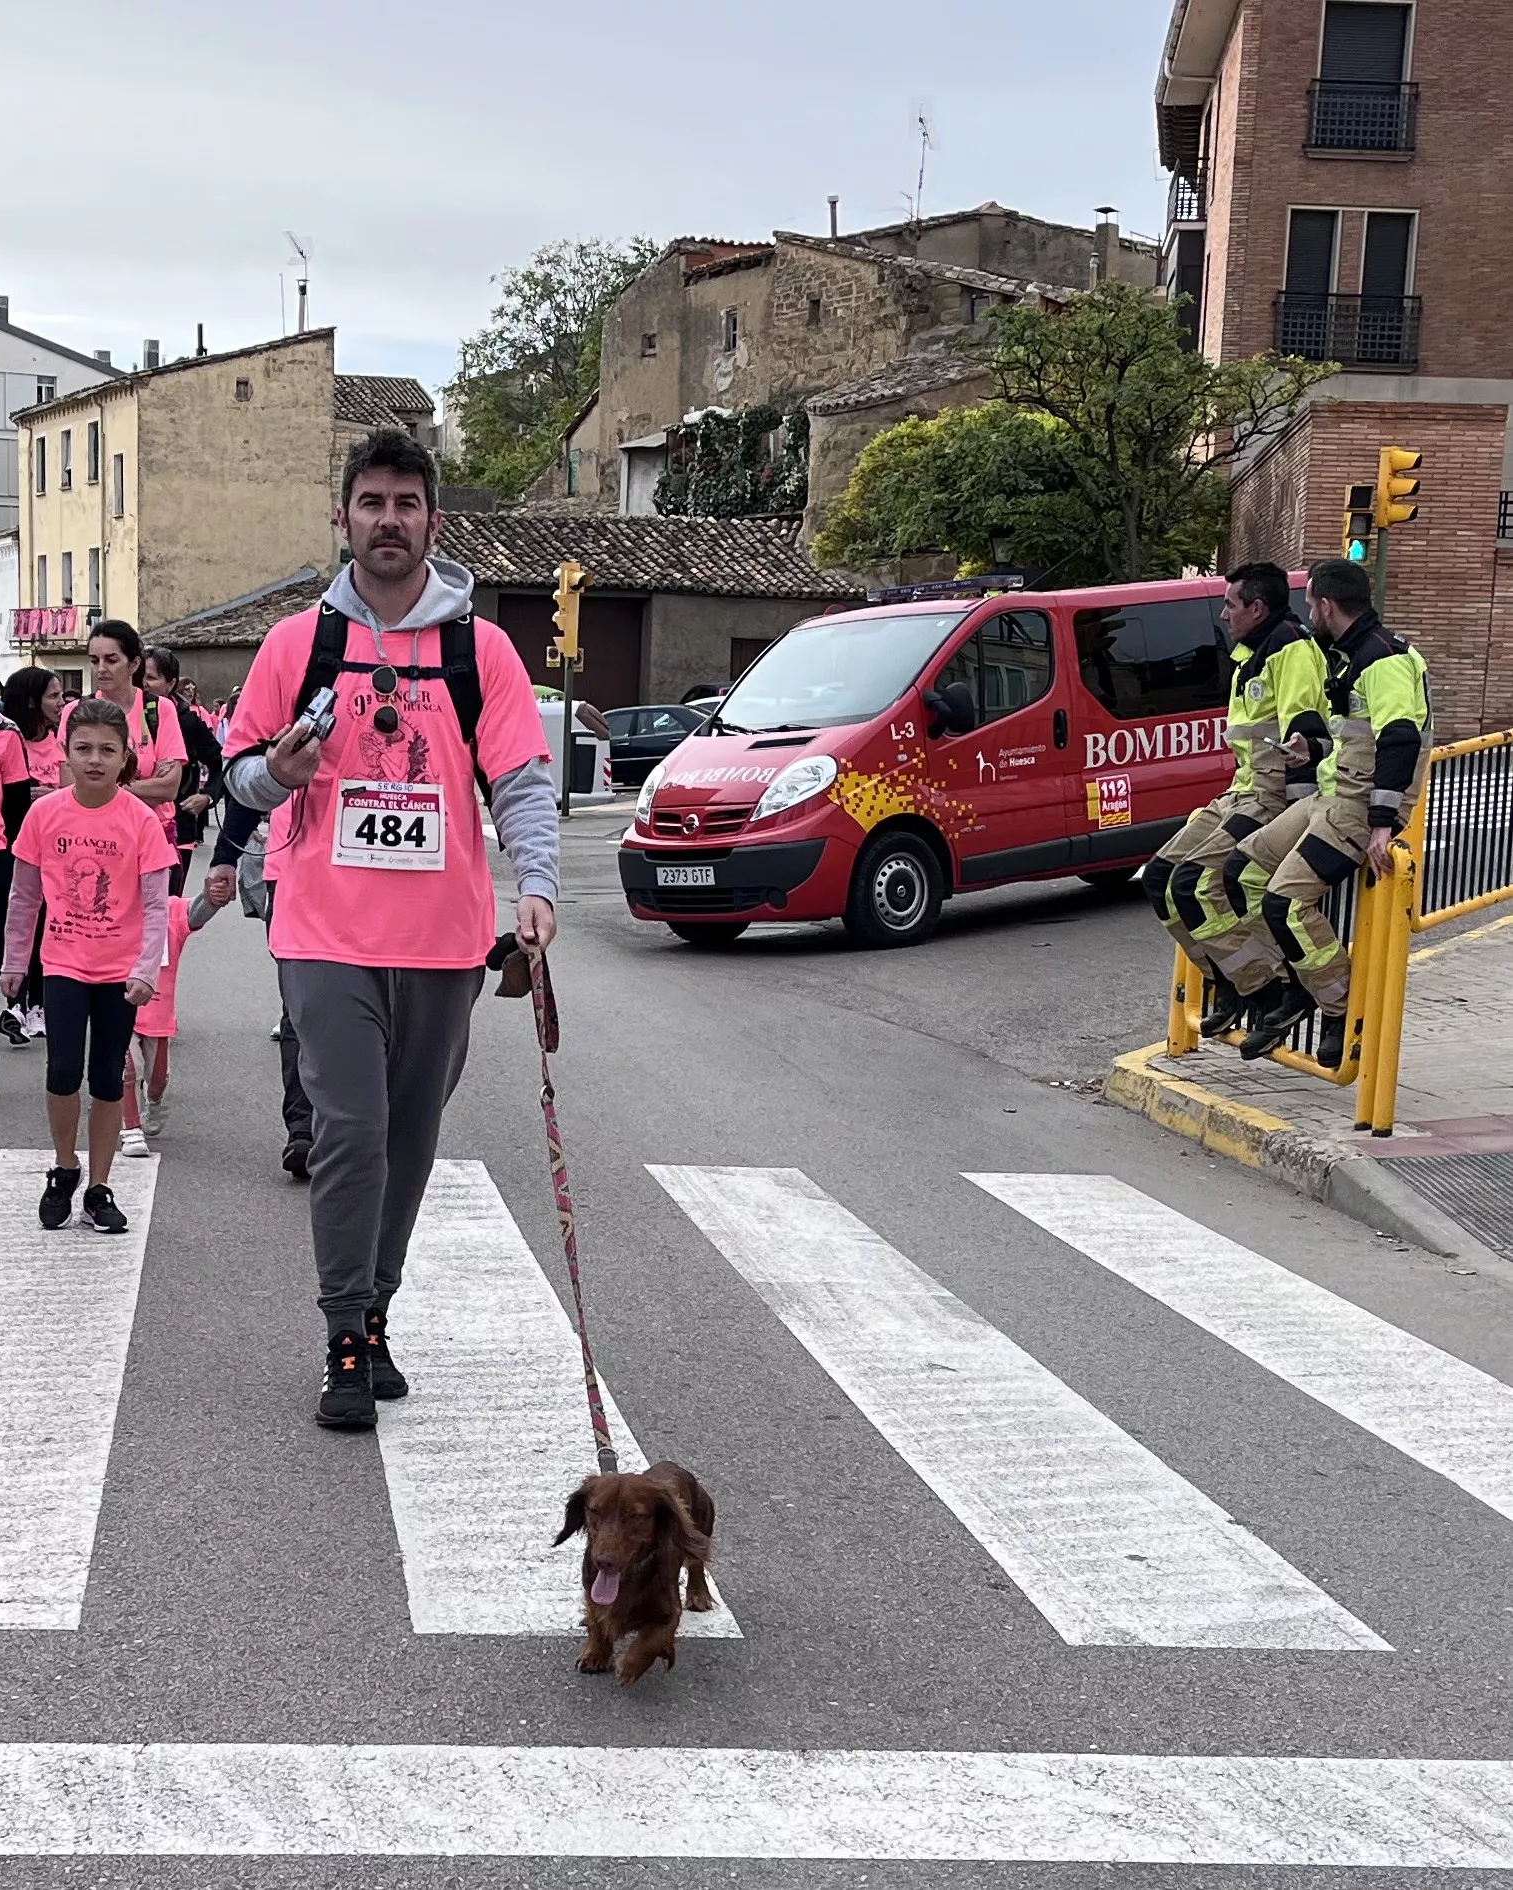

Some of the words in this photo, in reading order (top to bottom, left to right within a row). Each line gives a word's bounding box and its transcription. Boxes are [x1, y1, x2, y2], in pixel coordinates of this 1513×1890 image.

[403, 703, 442, 712] HUESCA
[890, 721, 915, 740] L-3
[1083, 716, 1229, 770] BOMBER
[998, 744, 1046, 757] Ayuntamiento
[999, 759, 1008, 769] de
[1009, 756, 1036, 767] Huesca
[377, 782, 414, 792] SERGIO
[1100, 779, 1127, 798] 112
[379, 793, 408, 801] HUESCA
[348, 798, 386, 809] CONTRA
[388, 801, 399, 810] EL
[401, 800, 436, 811] CÁNCER
[1102, 798, 1128, 812] Aragón
[355, 813, 427, 848] 484
[662, 869, 689, 884] 2373
[691, 868, 712, 883] GTF
